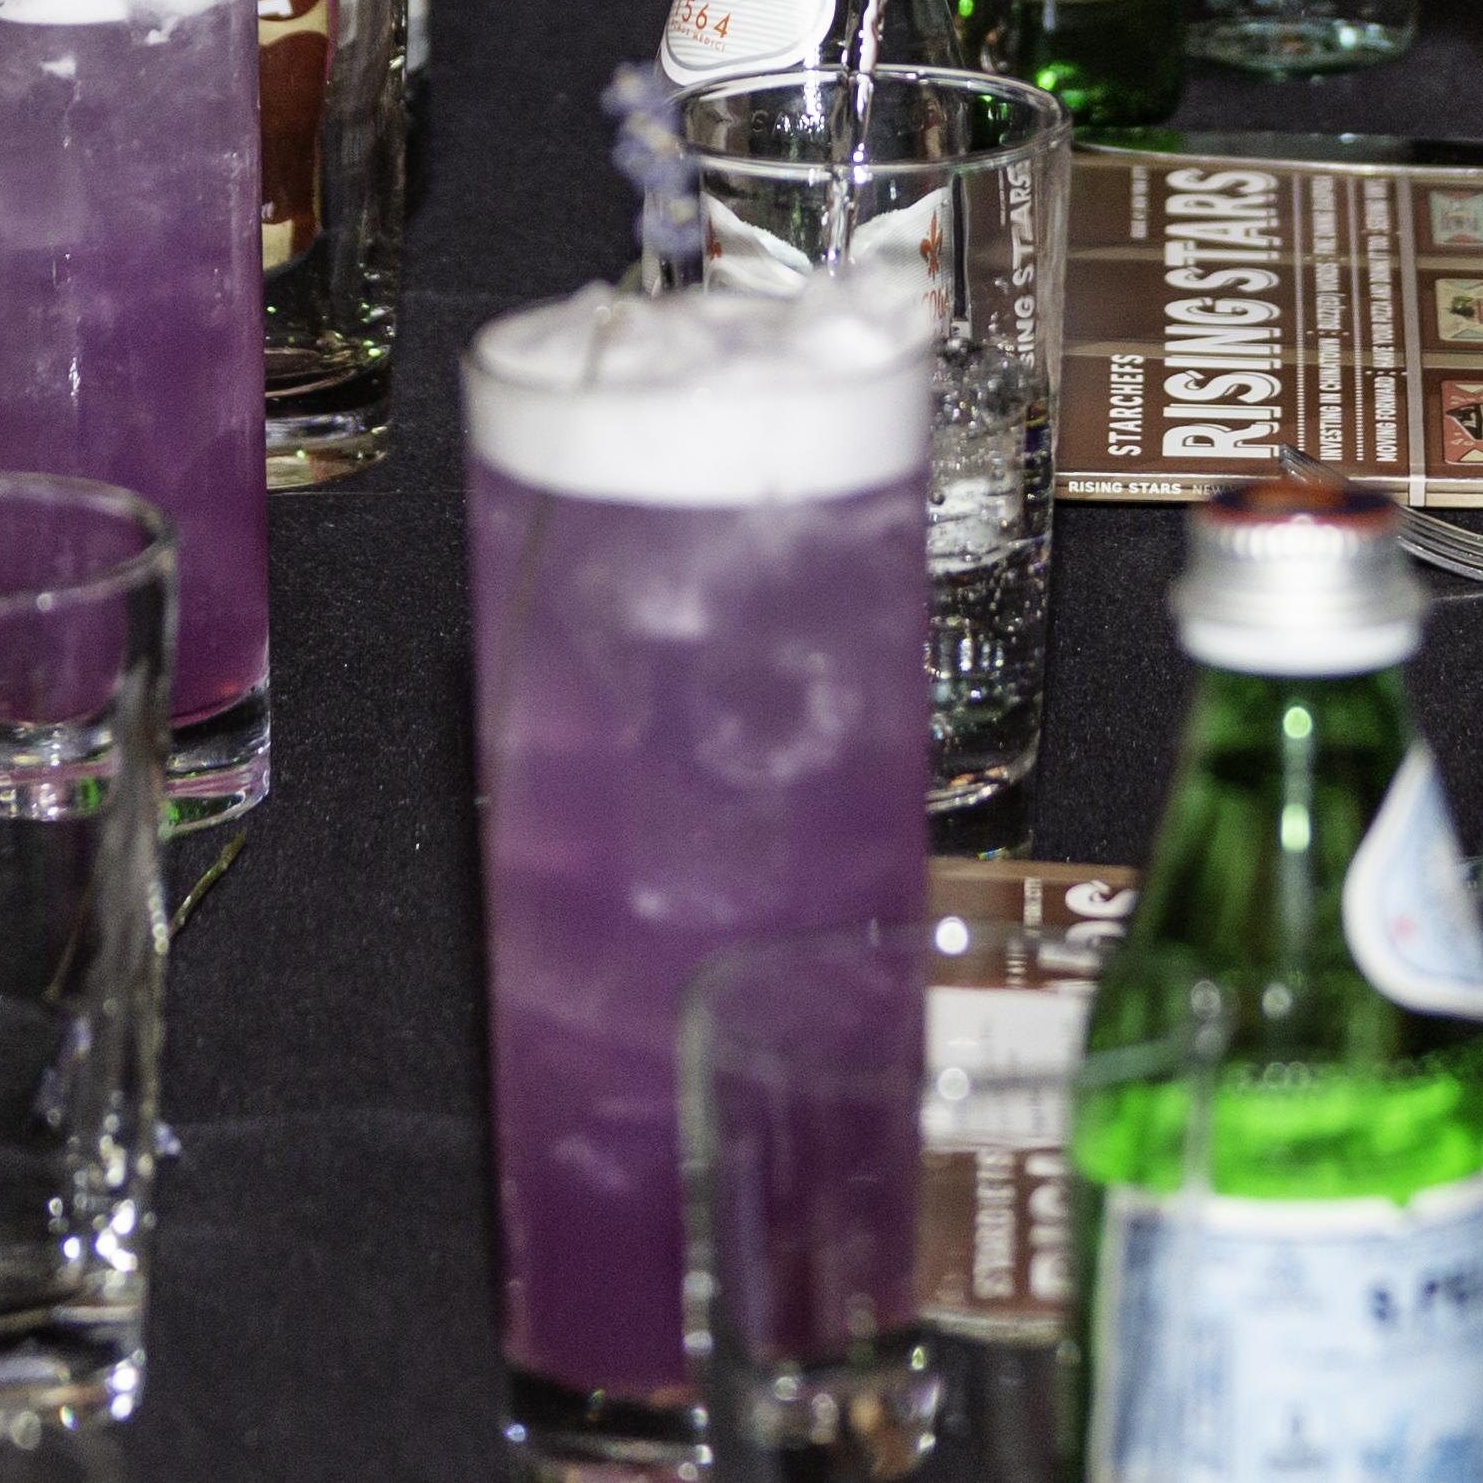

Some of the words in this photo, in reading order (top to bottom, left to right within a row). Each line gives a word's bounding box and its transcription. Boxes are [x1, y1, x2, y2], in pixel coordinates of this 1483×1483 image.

[1164, 166, 1282, 293] STARS
[1315, 262, 1340, 291] WORDS
[1369, 284, 1392, 299] AND
[1315, 292, 1347, 331] BUZZ(ED)
[1370, 301, 1394, 323] PIZZA
[1371, 323, 1395, 345] YOUR
[1316, 338, 1342, 391] CHINATOWN
[1372, 346, 1396, 369] HAVE
[1161, 297, 1283, 459] RISING
[1107, 354, 1145, 457] STARCHEFS
[1318, 393, 1342, 404] IN
[1373, 376, 1398, 421] FORWARD
[1318, 405, 1343, 461] INVESTING
[1374, 422, 1398, 463] MOVING
[1068, 480, 1123, 494] RISING
[1128, 481, 1183, 495] STARS
